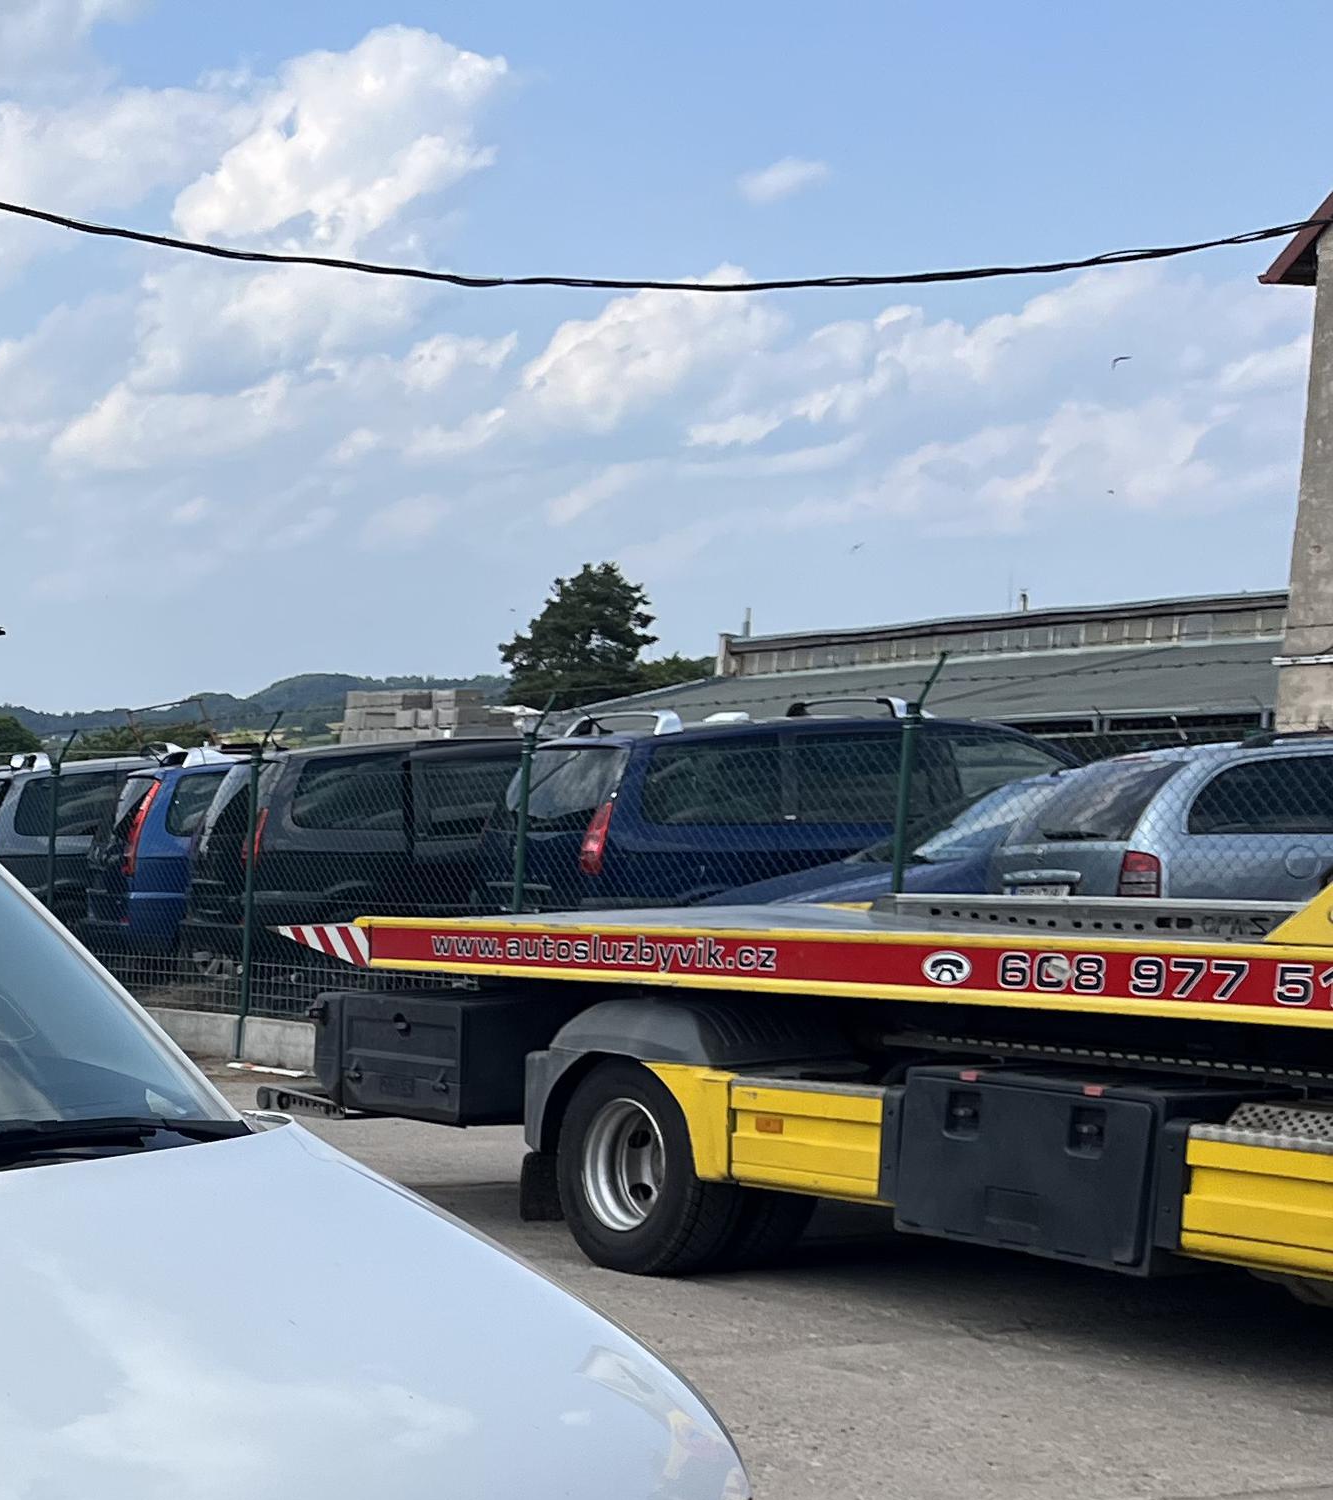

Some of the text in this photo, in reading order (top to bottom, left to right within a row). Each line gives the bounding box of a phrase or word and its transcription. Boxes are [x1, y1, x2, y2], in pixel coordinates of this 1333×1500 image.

[431, 934, 777, 973] www.autosluzbyvik.cz
[996, 950, 1107, 994] 608
[1129, 955, 1249, 1000] 977
